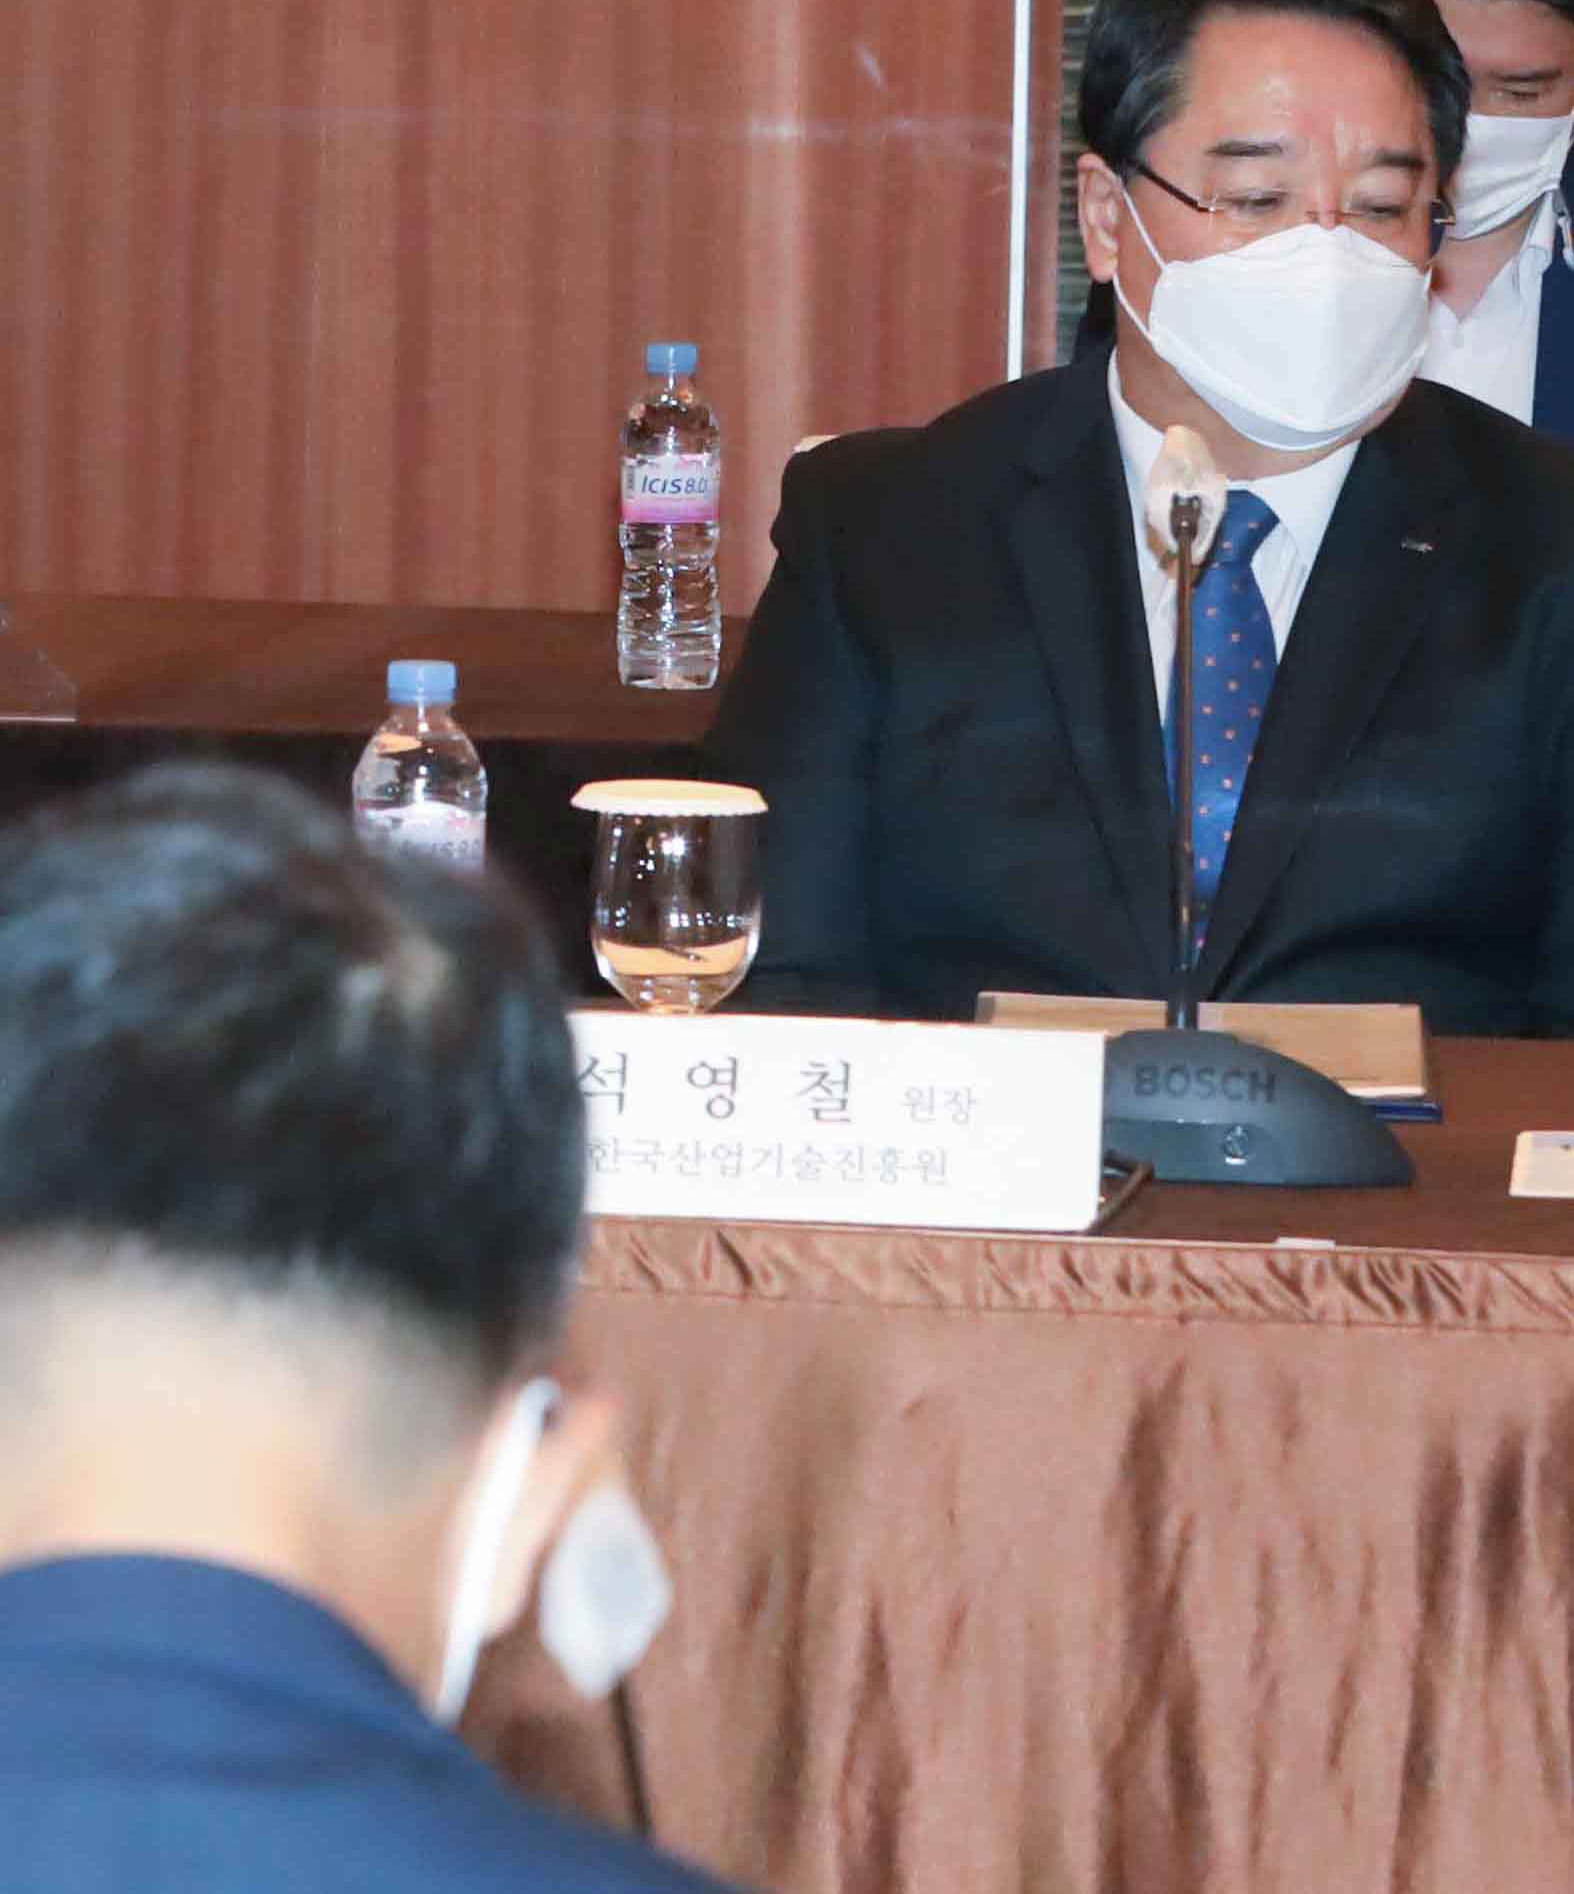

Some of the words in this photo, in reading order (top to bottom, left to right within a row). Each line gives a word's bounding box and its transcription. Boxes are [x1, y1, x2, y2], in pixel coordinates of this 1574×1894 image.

[902, 1084, 977, 1126] 원장
[1133, 1063, 1278, 1105] BOSCH
[588, 1136, 952, 1187] 한국산업기술진흥원
